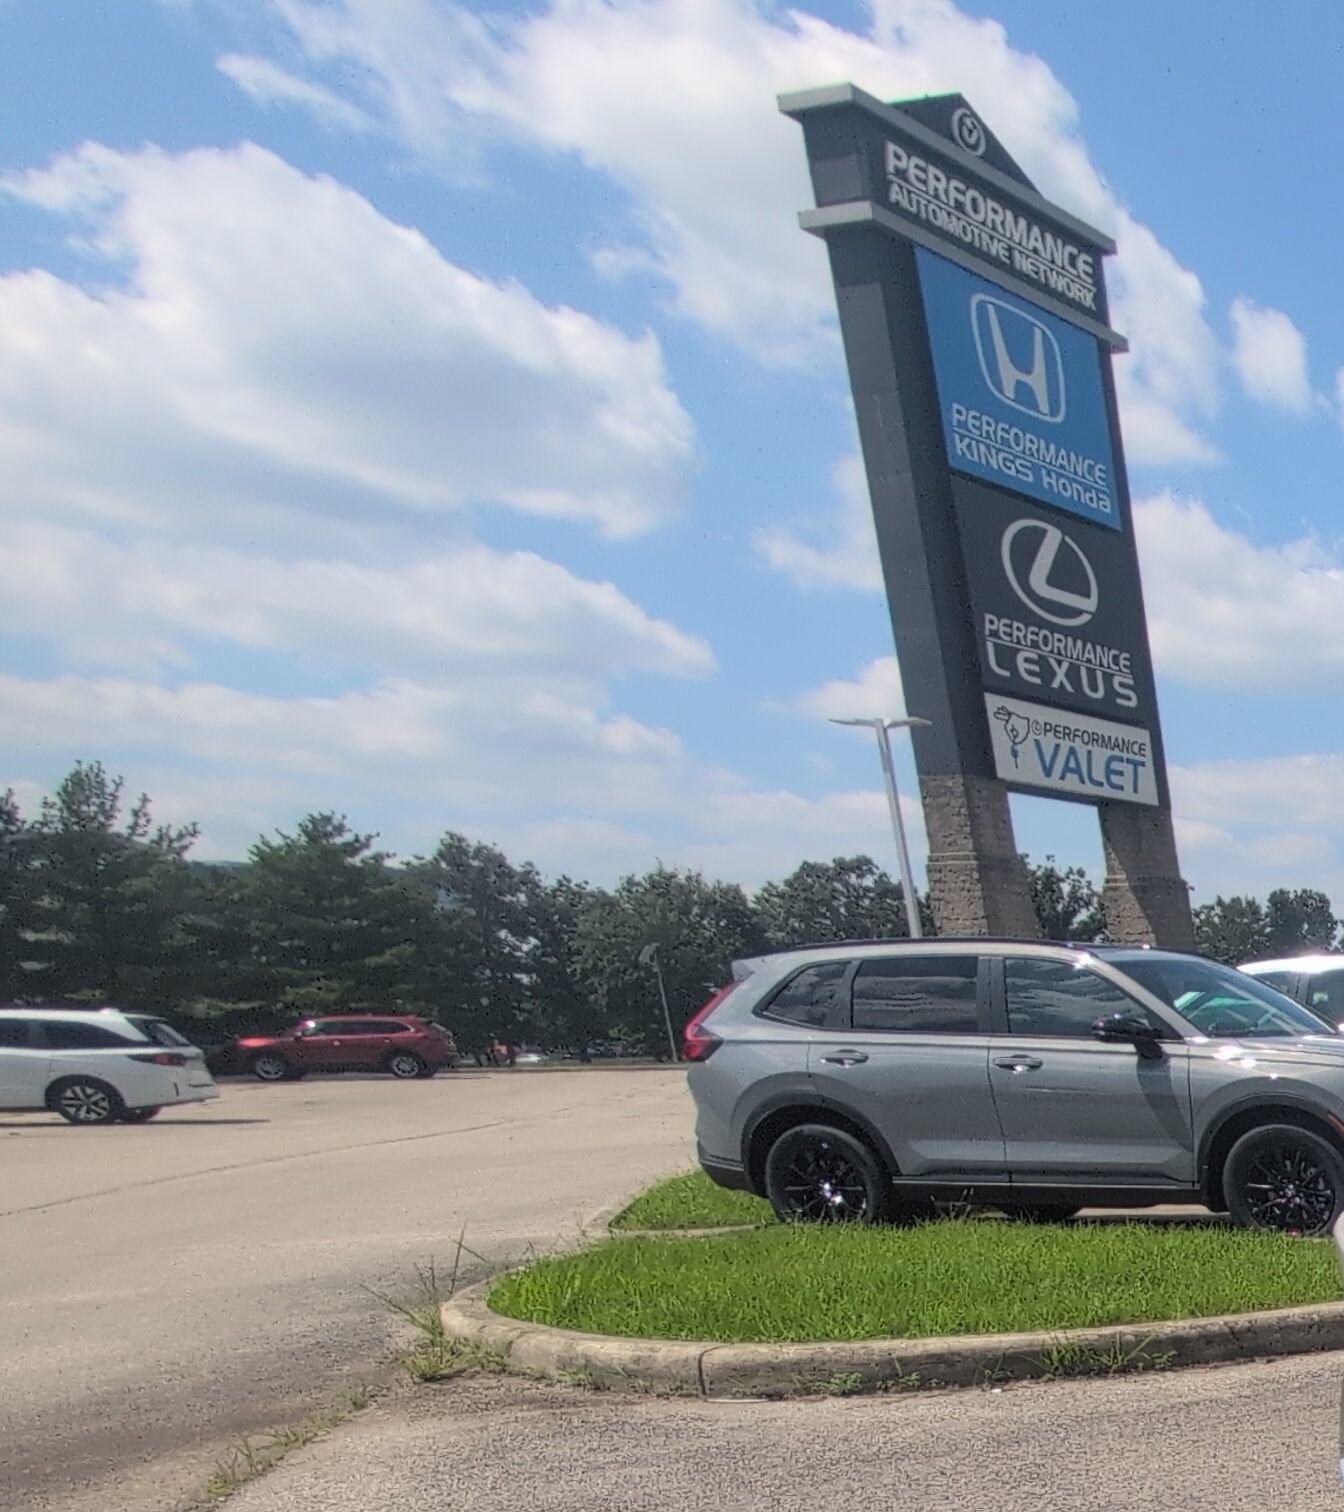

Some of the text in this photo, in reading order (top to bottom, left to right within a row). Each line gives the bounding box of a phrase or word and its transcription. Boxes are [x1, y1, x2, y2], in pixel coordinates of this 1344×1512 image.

[884, 140, 1094, 283] PERFORMANCE
[889, 183, 1096, 311] AUTOMOTIVE NETWORK
[952, 402, 1108, 487] PERFORMANCE
[953, 433, 1034, 482] KINGS
[984, 613, 1131, 674] PERFORMANCE
[986, 640, 1138, 708] LEXUS
[1033, 738, 1146, 794] VALET
[1043, 722, 1147, 758] PERFORMANCE
